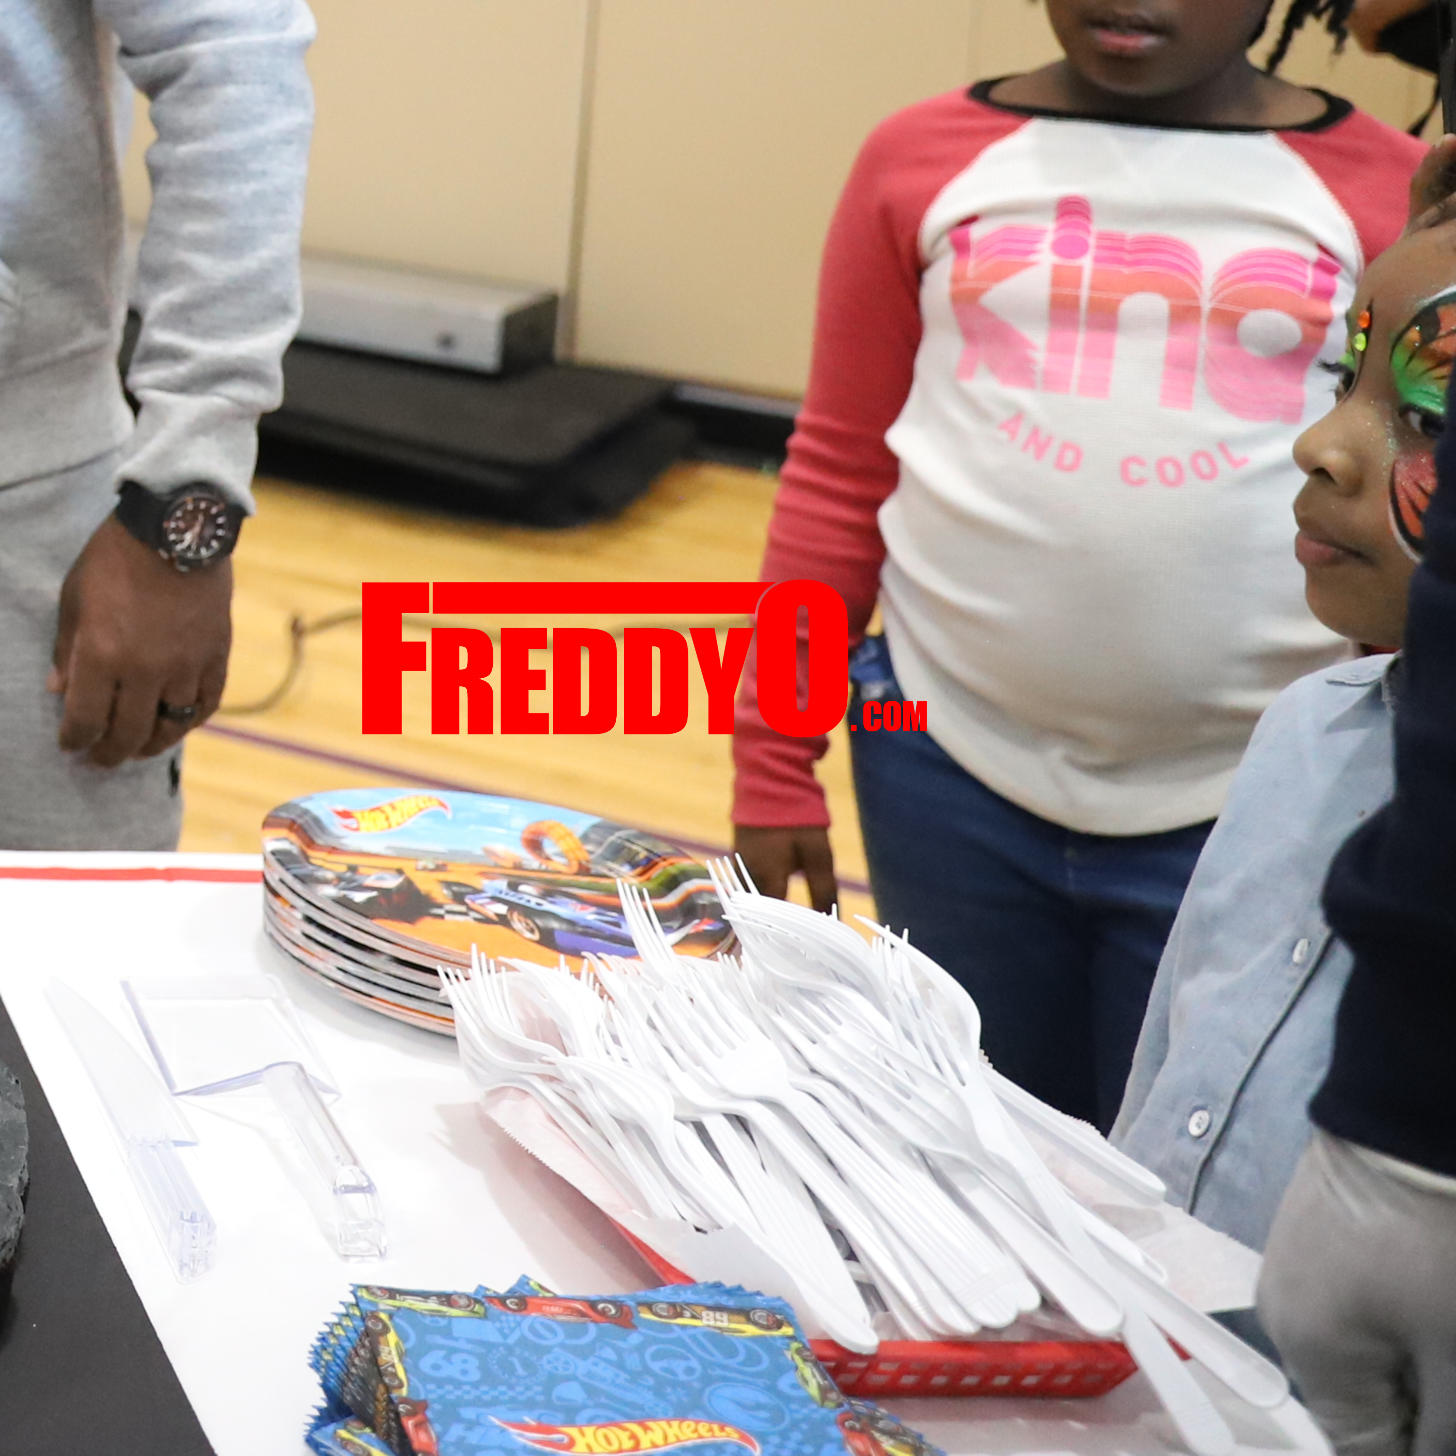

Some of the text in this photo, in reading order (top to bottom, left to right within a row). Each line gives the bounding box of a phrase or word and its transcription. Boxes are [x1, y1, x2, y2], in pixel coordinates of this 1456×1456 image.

[997, 411, 1250, 488] AND COOL
[569, 1422, 636, 1454] HOT
